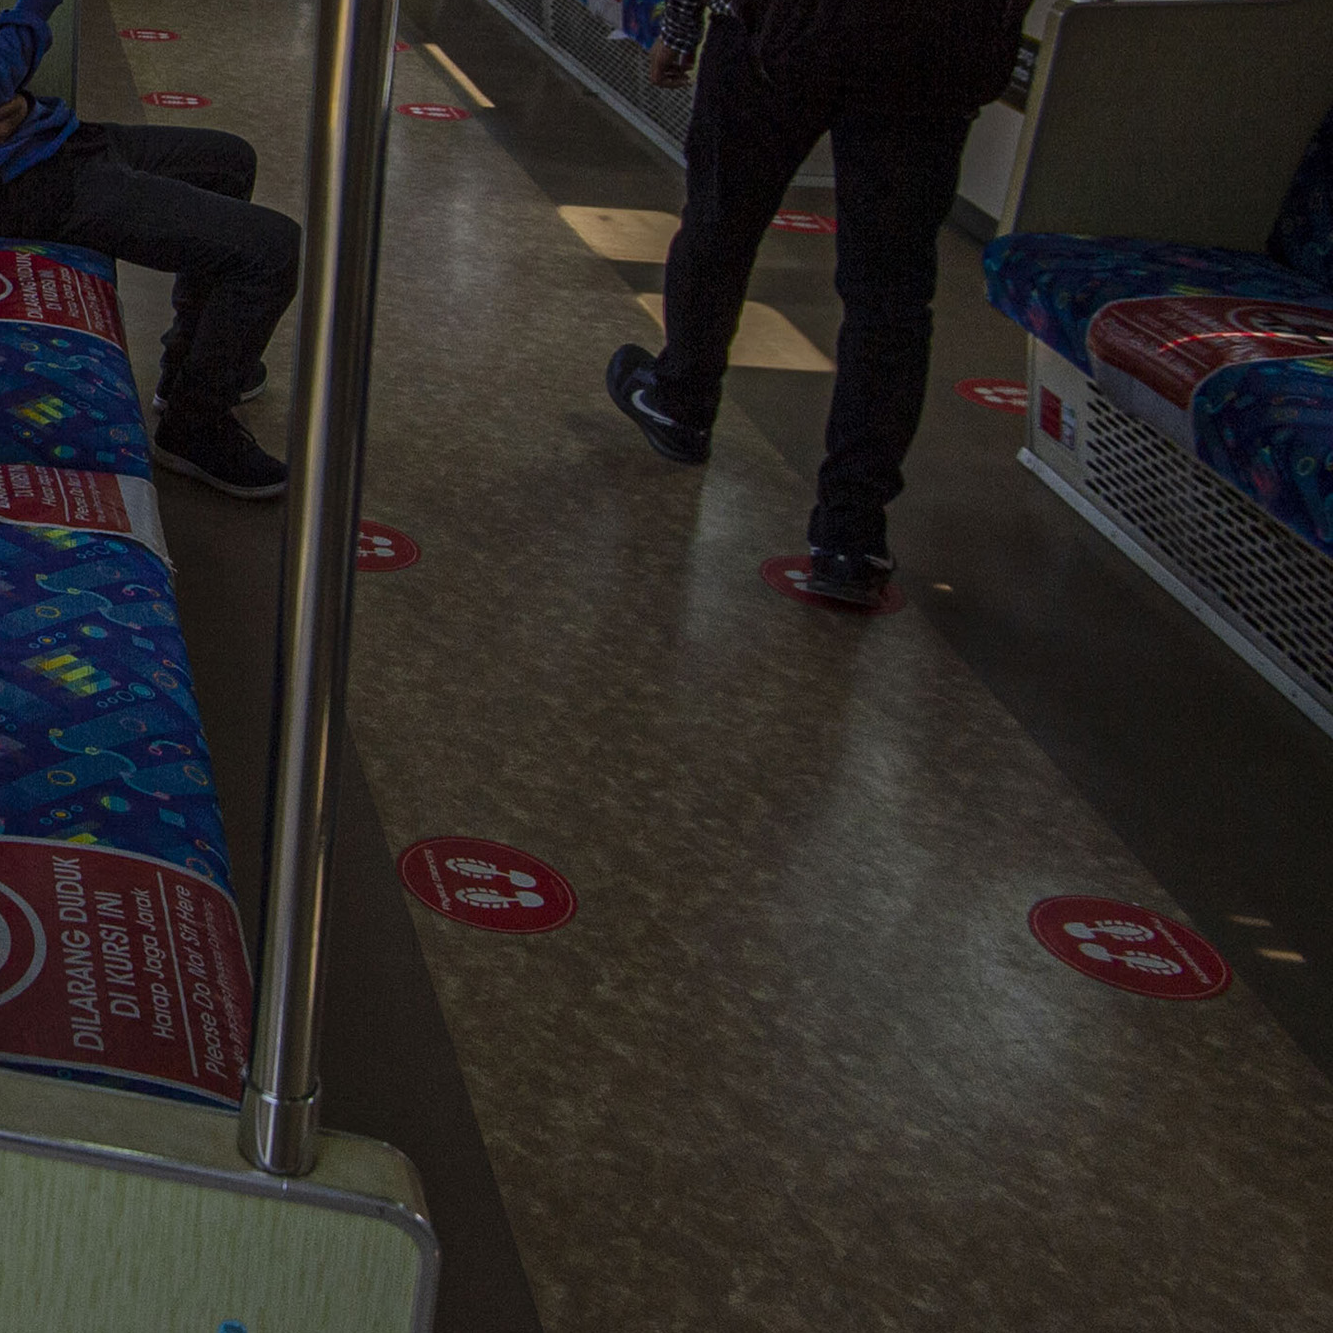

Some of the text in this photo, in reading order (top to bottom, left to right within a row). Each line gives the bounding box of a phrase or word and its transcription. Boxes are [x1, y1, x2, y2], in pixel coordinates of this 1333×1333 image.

[52, 855, 105, 1051] DILARANG DUDUK
[93, 889, 141, 1019] DI KURSI INI
[131, 886, 176, 1040] Harap Jaga Jarak
[173, 884, 229, 1080] Please Do Not Sit Here
